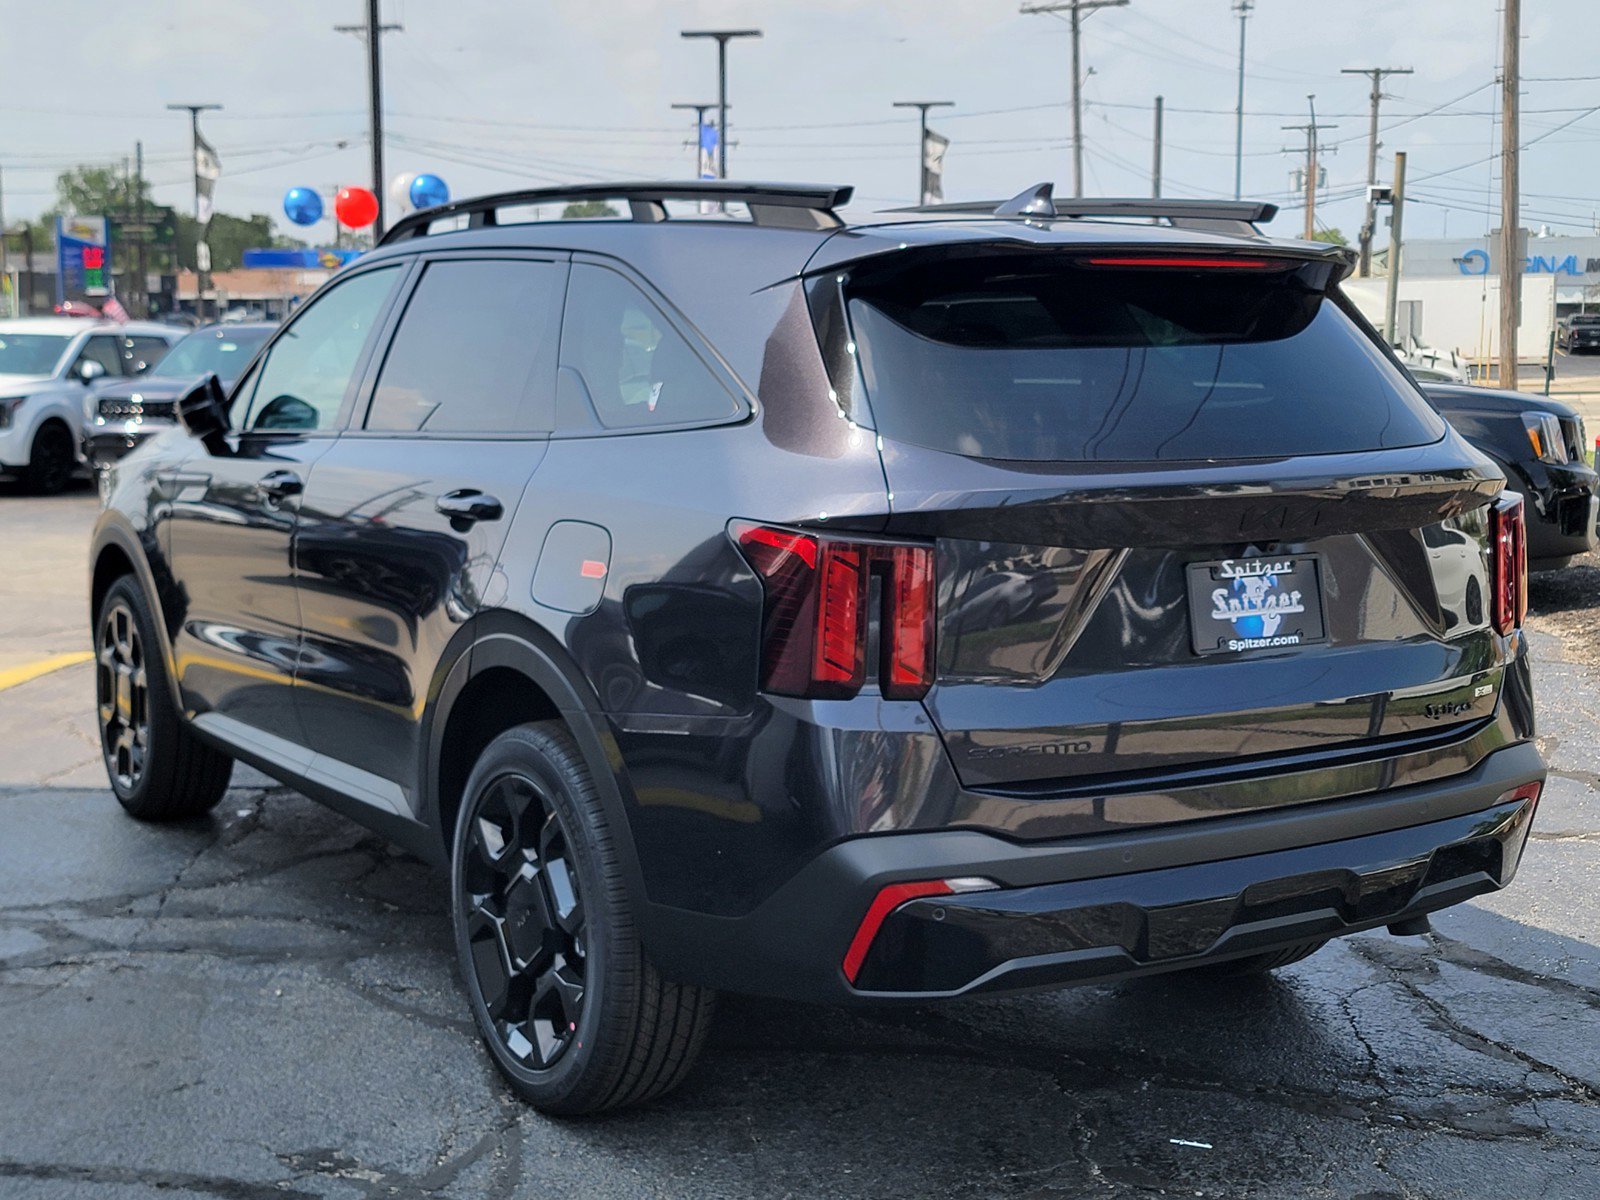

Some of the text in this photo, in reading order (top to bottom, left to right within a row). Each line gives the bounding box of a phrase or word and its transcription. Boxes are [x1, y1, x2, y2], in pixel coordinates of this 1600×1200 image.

[1221, 560, 1292, 579] Spitzer
[1212, 588, 1304, 622] Spitzer
[1228, 635, 1299, 651] Spitzer.com
